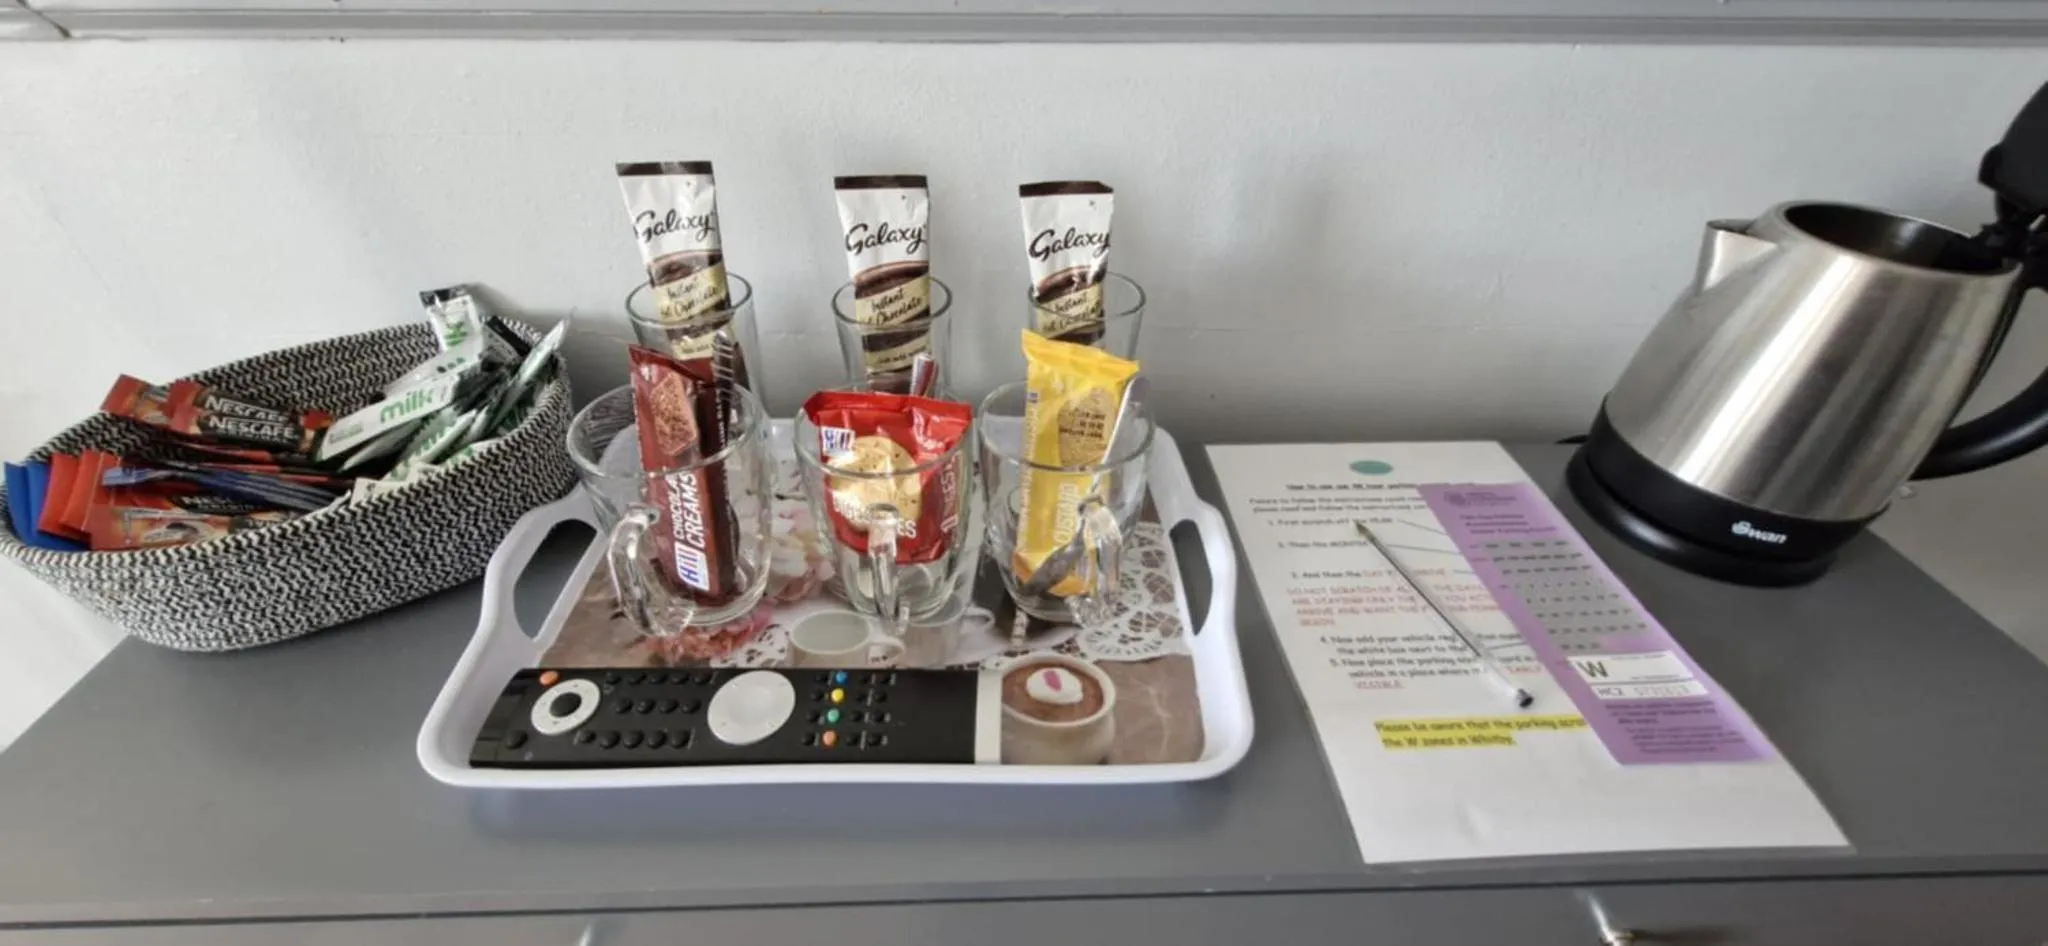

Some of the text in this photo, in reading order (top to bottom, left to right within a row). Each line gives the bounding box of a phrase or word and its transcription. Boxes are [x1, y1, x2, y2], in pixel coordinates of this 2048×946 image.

[633, 208, 716, 243] Galaxy
[845, 222, 927, 255] Galaxy
[1029, 226, 1111, 262] Galaxy
[871, 288, 905, 312] Instant
[379, 388, 434, 423] milk
[681, 470, 705, 549] CREAMS
[1731, 520, 1788, 544] Swan
[1575, 660, 1609, 679] W
